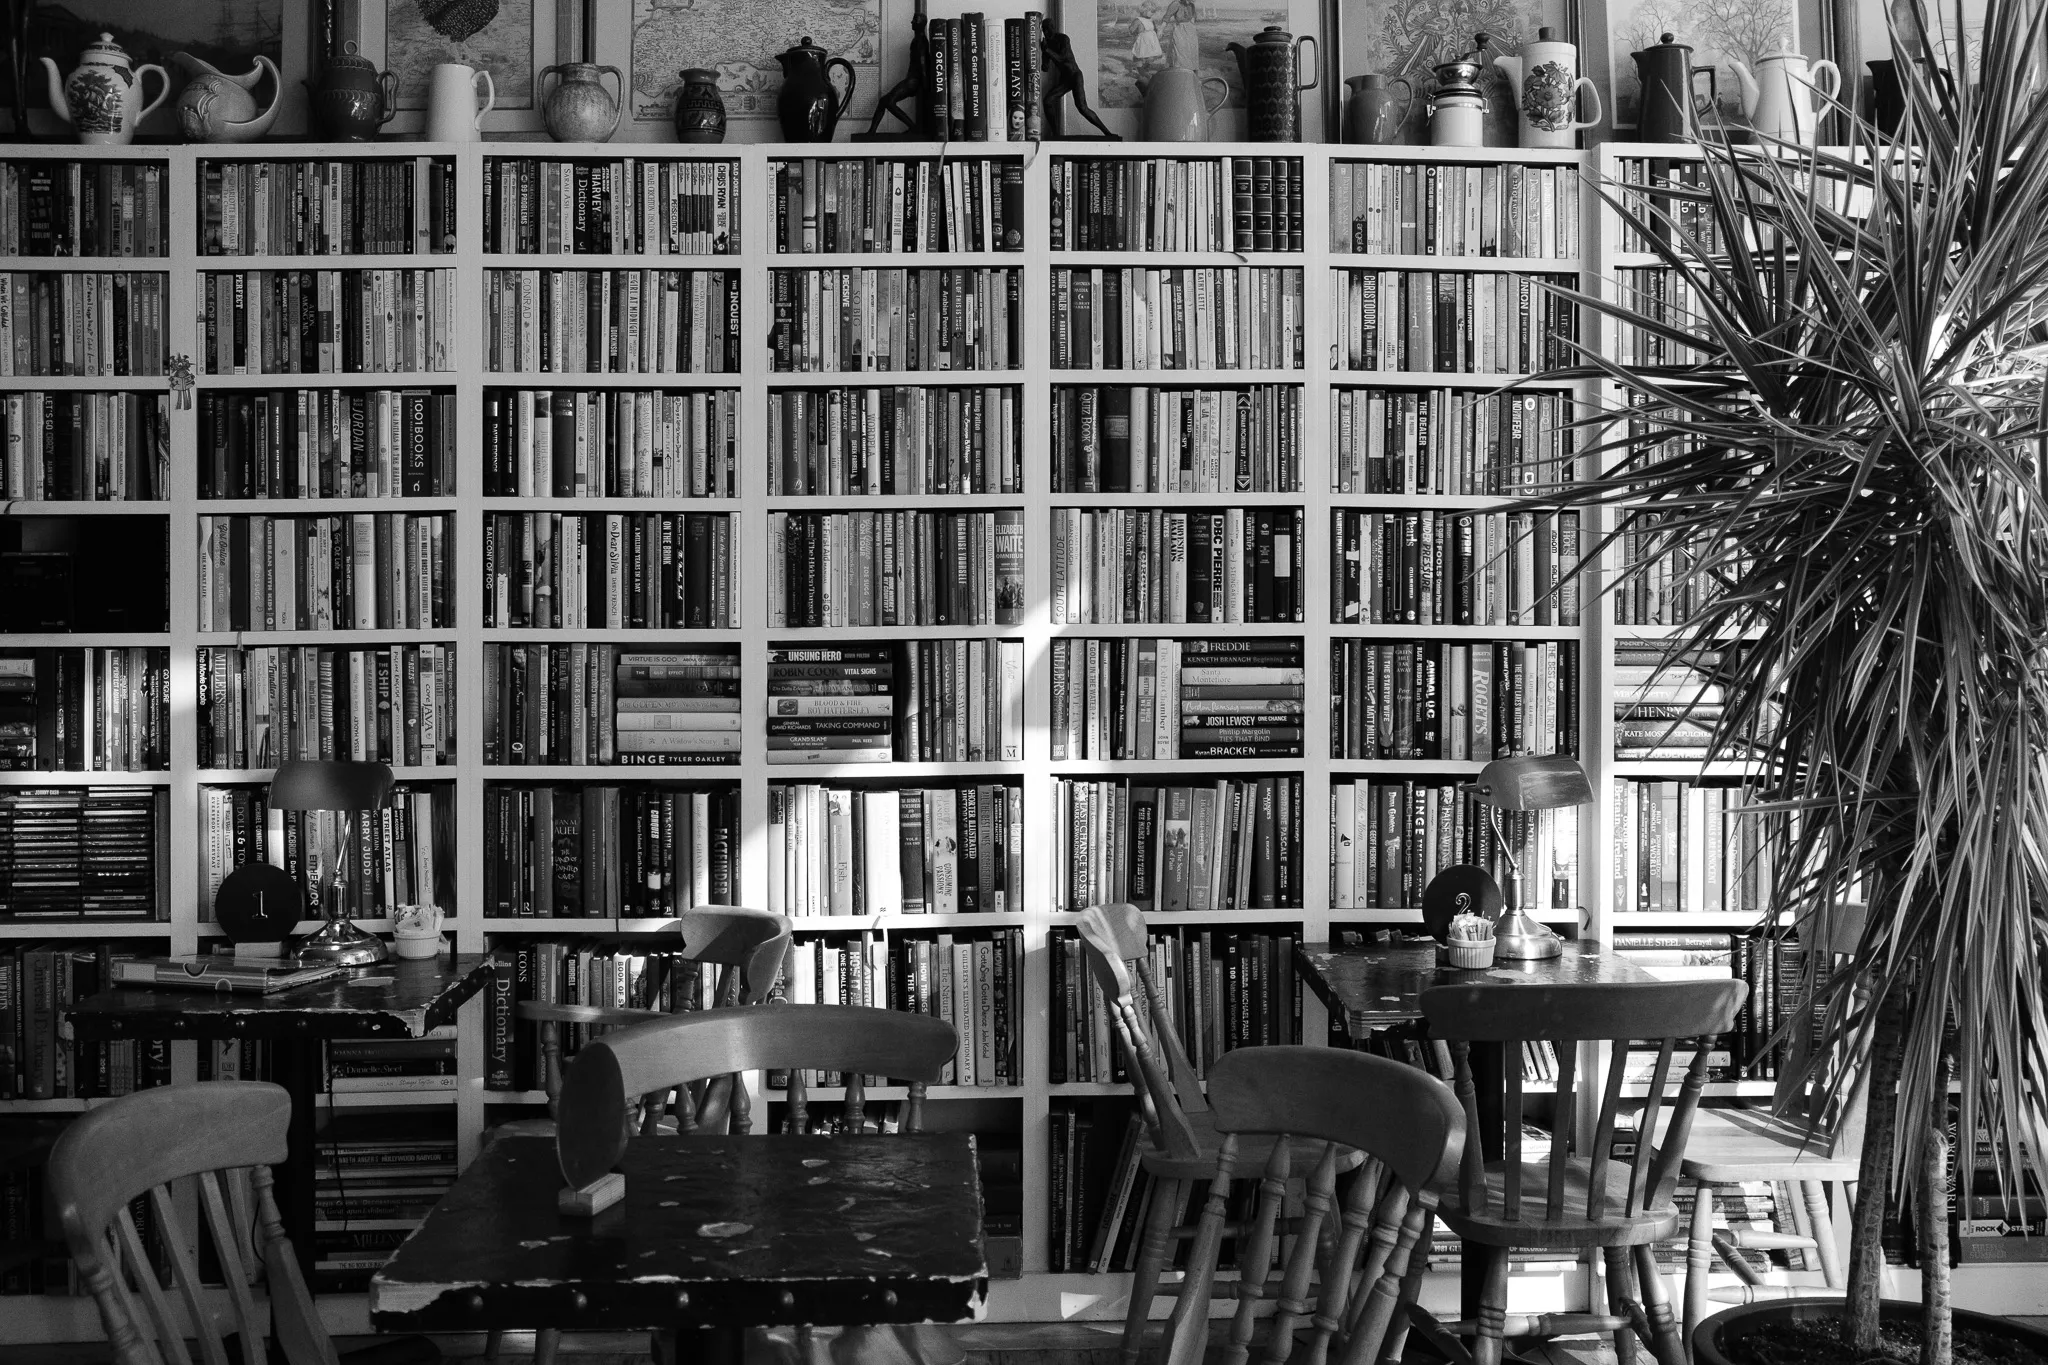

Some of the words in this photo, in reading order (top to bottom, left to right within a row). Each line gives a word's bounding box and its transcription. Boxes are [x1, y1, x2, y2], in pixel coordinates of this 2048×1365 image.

[935, 52, 944, 93] ORCADIA
[1011, 60, 1021, 98] PLAYS
[576, 179, 588, 232] Dictionary
[592, 174, 601, 212] HARVEY
[1, 295, 8, 304] We
[235, 274, 243, 309] PERFECT
[416, 273, 424, 312] CONRAD
[523, 277, 531, 319] CONRAD
[1364, 276, 1375, 329] CHRISTODORA
[1081, 392, 1091, 414] QUIZ
[1419, 401, 1427, 416] THE
[46, 420, 53, 430] GO
[353, 407, 364, 451] JORDAN
[1081, 417, 1091, 442] BOOK
[1419, 417, 1427, 445] DEALER
[663, 521, 671, 530] ON
[663, 532, 671, 544] THE
[884, 514, 892, 544] MICHAEL
[958, 519, 966, 551] ORGANISE
[1213, 518, 1222, 544] DBC
[1406, 516, 1417, 546] Pearls
[1422, 518, 1431, 542] UNDER
[486, 564, 493, 572] OF
[663, 546, 671, 565] BRINK
[884, 547, 892, 573] MOORE
[1422, 544, 1431, 592] PRESSURE
[958, 553, 966, 584] YOURSELF
[1213, 548, 1222, 591] PIERRE
[788, 651, 820, 661] UNSUNG
[821, 651, 842, 661] HERO
[1159, 647, 1168, 663] The
[1210, 642, 1251, 651] FREDDIE
[1547, 645, 1555, 658] THE
[773, 667, 805, 677] ROBIN
[807, 667, 840, 677] COOK
[945, 648, 953, 707] GOGGLEBOX
[1054, 646, 1065, 696] MILLER'S
[1159, 665, 1168, 689] Echo
[1383, 660, 1391, 671] THE
[1547, 660, 1555, 675] BEST
[378, 669, 389, 697] SHIP
[1383, 673, 1391, 703] STARTUP
[1547, 678, 1555, 692] OF
[1159, 691, 1168, 730] Chamber
[1383, 706, 1391, 722] WIFE
[1473, 669, 1489, 734] ROGET'S
[1547, 695, 1555, 714] SAIL
[1638, 706, 1682, 717] HENRY
[424, 703, 435, 731] JAVA
[1547, 716, 1555, 733] TRIM
[621, 755, 665, 764] BINGE
[1210, 747, 1256, 755] BRACKEN
[1106, 787, 1114, 802] The
[237, 806, 246, 835] DOLLS
[1079, 801, 1087, 823] LAST
[1106, 805, 1114, 830] Rules
[1416, 790, 1425, 836] BINGE
[1079, 826, 1087, 865] CHANCE
[1106, 841, 1114, 871] Action
[362, 846, 372, 875] JUDD
[714, 827, 727, 894] FACTFINDER
[1079, 868, 1087, 880] TO
[1079, 884, 1087, 900] SEE
[252, 891, 268, 919] 1
[1614, 937, 1652, 947] DANIELLE
[1655, 937, 1681, 947] STEEL
[1685, 937, 1711, 947] Betrayal
[518, 950, 527, 982] ICONS
[567, 959, 575, 986] DURRELL
[1229, 966, 1237, 979] 100
[1067, 986, 1075, 1009] Home
[1229, 981, 1237, 1004] Natural
[493, 978, 510, 1062] Dictionary
[979, 1005, 989, 1027] Dance
[1229, 1007, 1237, 1032] Wonders
[979, 1029, 989, 1041] John
[979, 1042, 989, 1059] Kobal
[1947, 1122, 1956, 1166] WORLD
[1947, 1169, 1956, 1199] WAR
[1947, 1201, 1956, 1213] II
